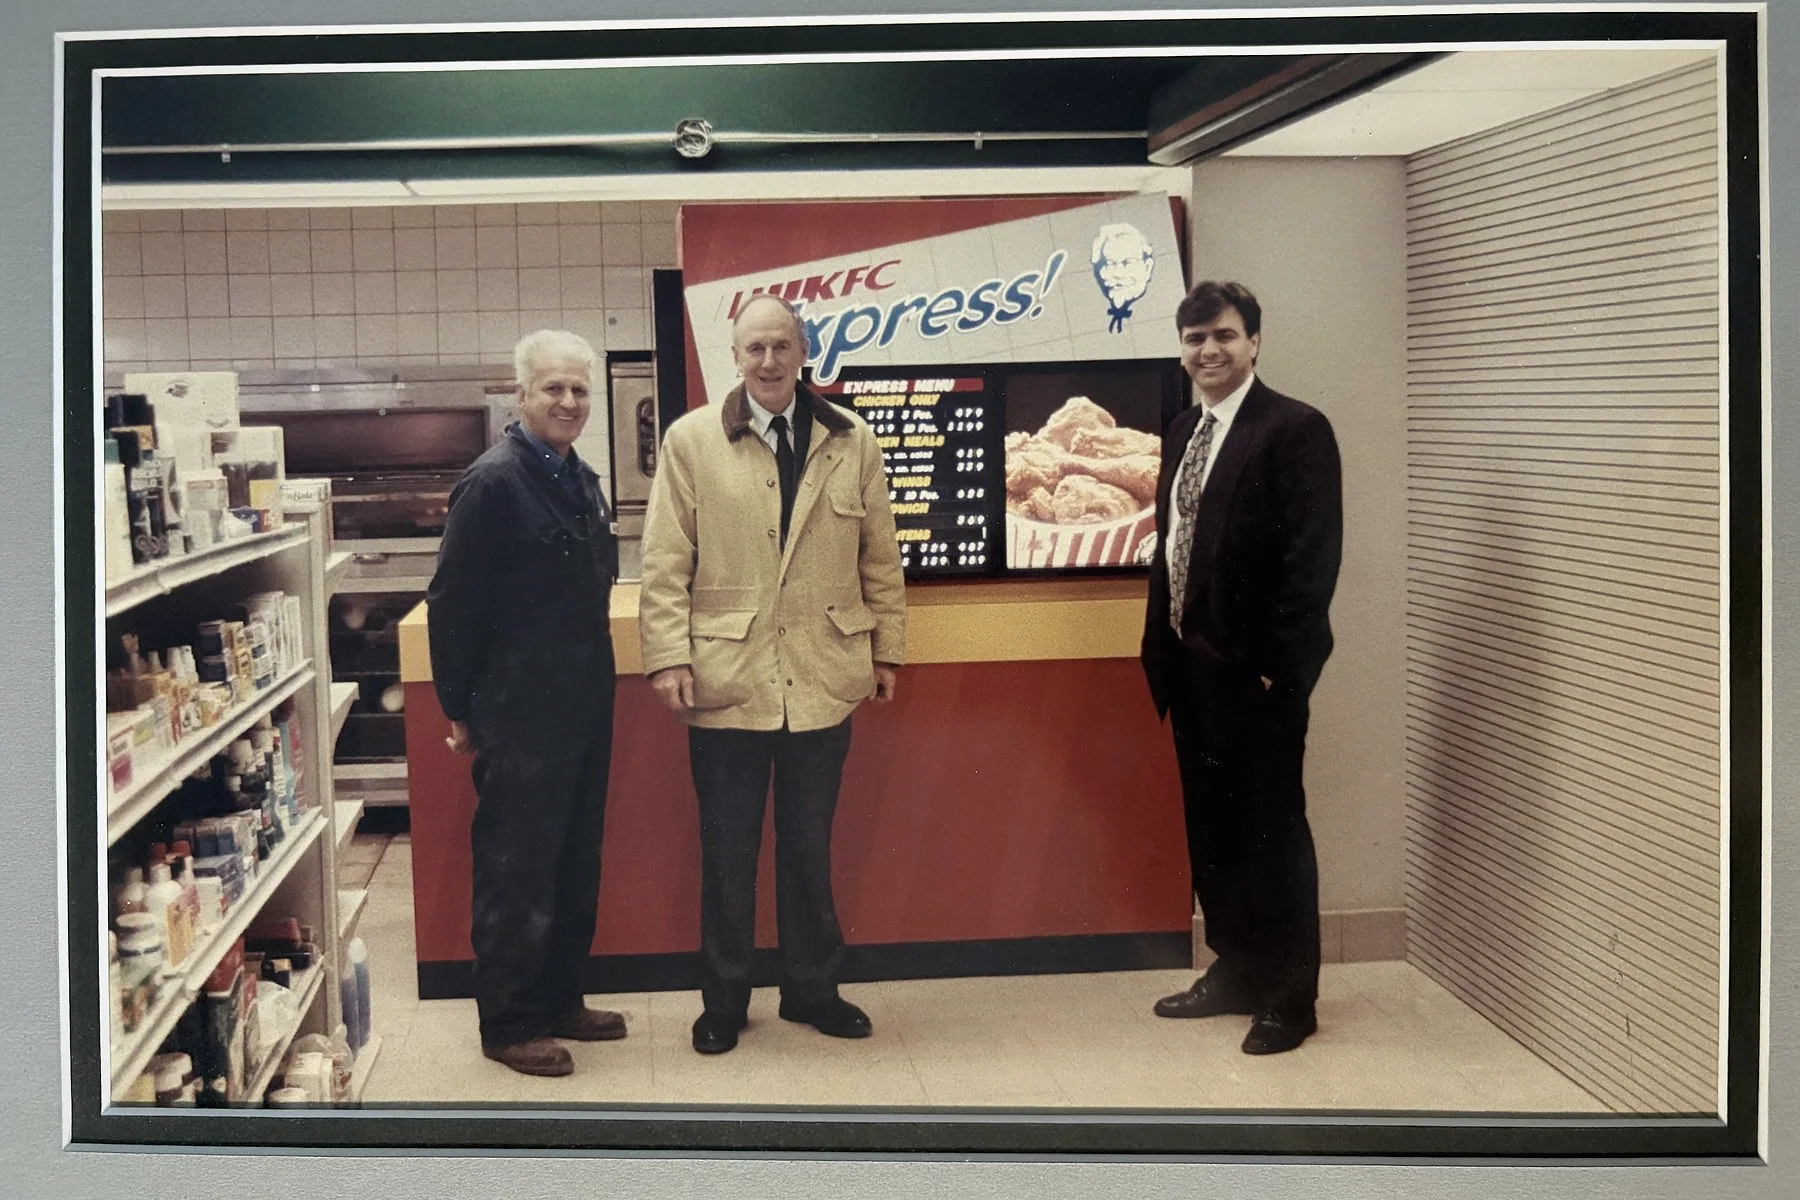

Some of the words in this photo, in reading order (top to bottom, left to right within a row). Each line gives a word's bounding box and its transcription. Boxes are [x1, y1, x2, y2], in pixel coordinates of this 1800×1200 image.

[801, 259, 902, 303] KFC
[793, 250, 1068, 384] xpress!
[843, 380, 909, 394] EXPRESS
[913, 378, 956, 393] MENU
[853, 395, 906, 407] CHICKEN
[909, 393, 941, 406] ONLY
[904, 435, 945, 447] MEALS
[892, 475, 932, 488] WINGS
